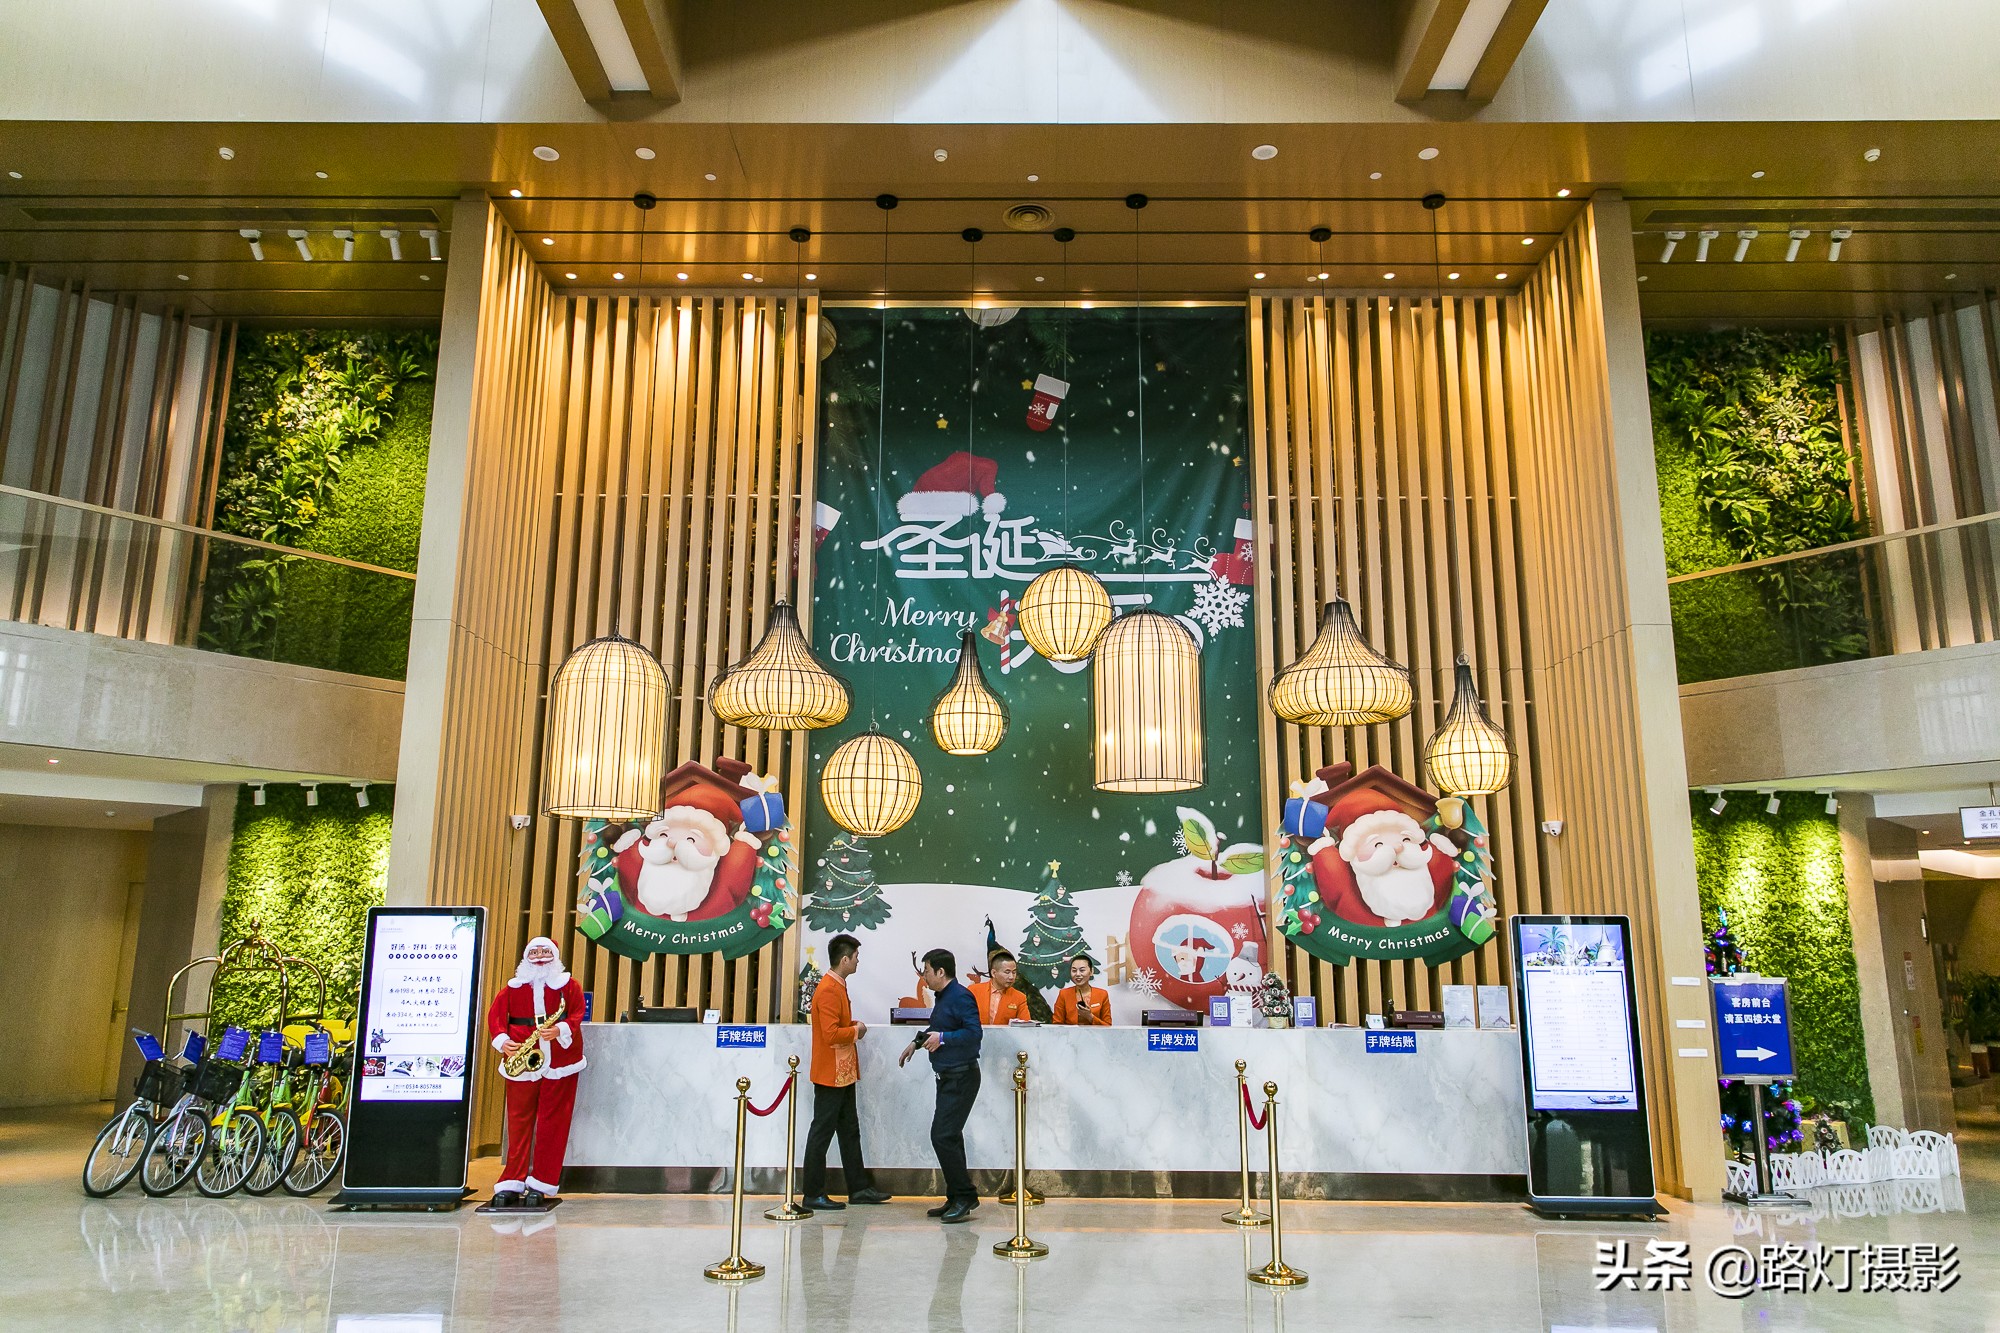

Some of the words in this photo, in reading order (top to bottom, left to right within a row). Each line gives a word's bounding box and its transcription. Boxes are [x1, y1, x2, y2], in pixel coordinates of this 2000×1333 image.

[880, 597, 978, 641] Merry
[830, 632, 962, 664] Christma
[624, 920, 666, 944] Merry
[671, 920, 744, 944] Christmas
[1328, 926, 1373, 950] Merry
[1378, 926, 1450, 950] Christmas
[1731, 997, 1771, 1008] 客房前台
[1724, 1013, 1782, 1025] 请至四楼大堂
[717, 1030, 765, 1043] 手牌结账
[1149, 1033, 1197, 1046] 手牌发放
[1366, 1035, 1415, 1048] 手牌结账
